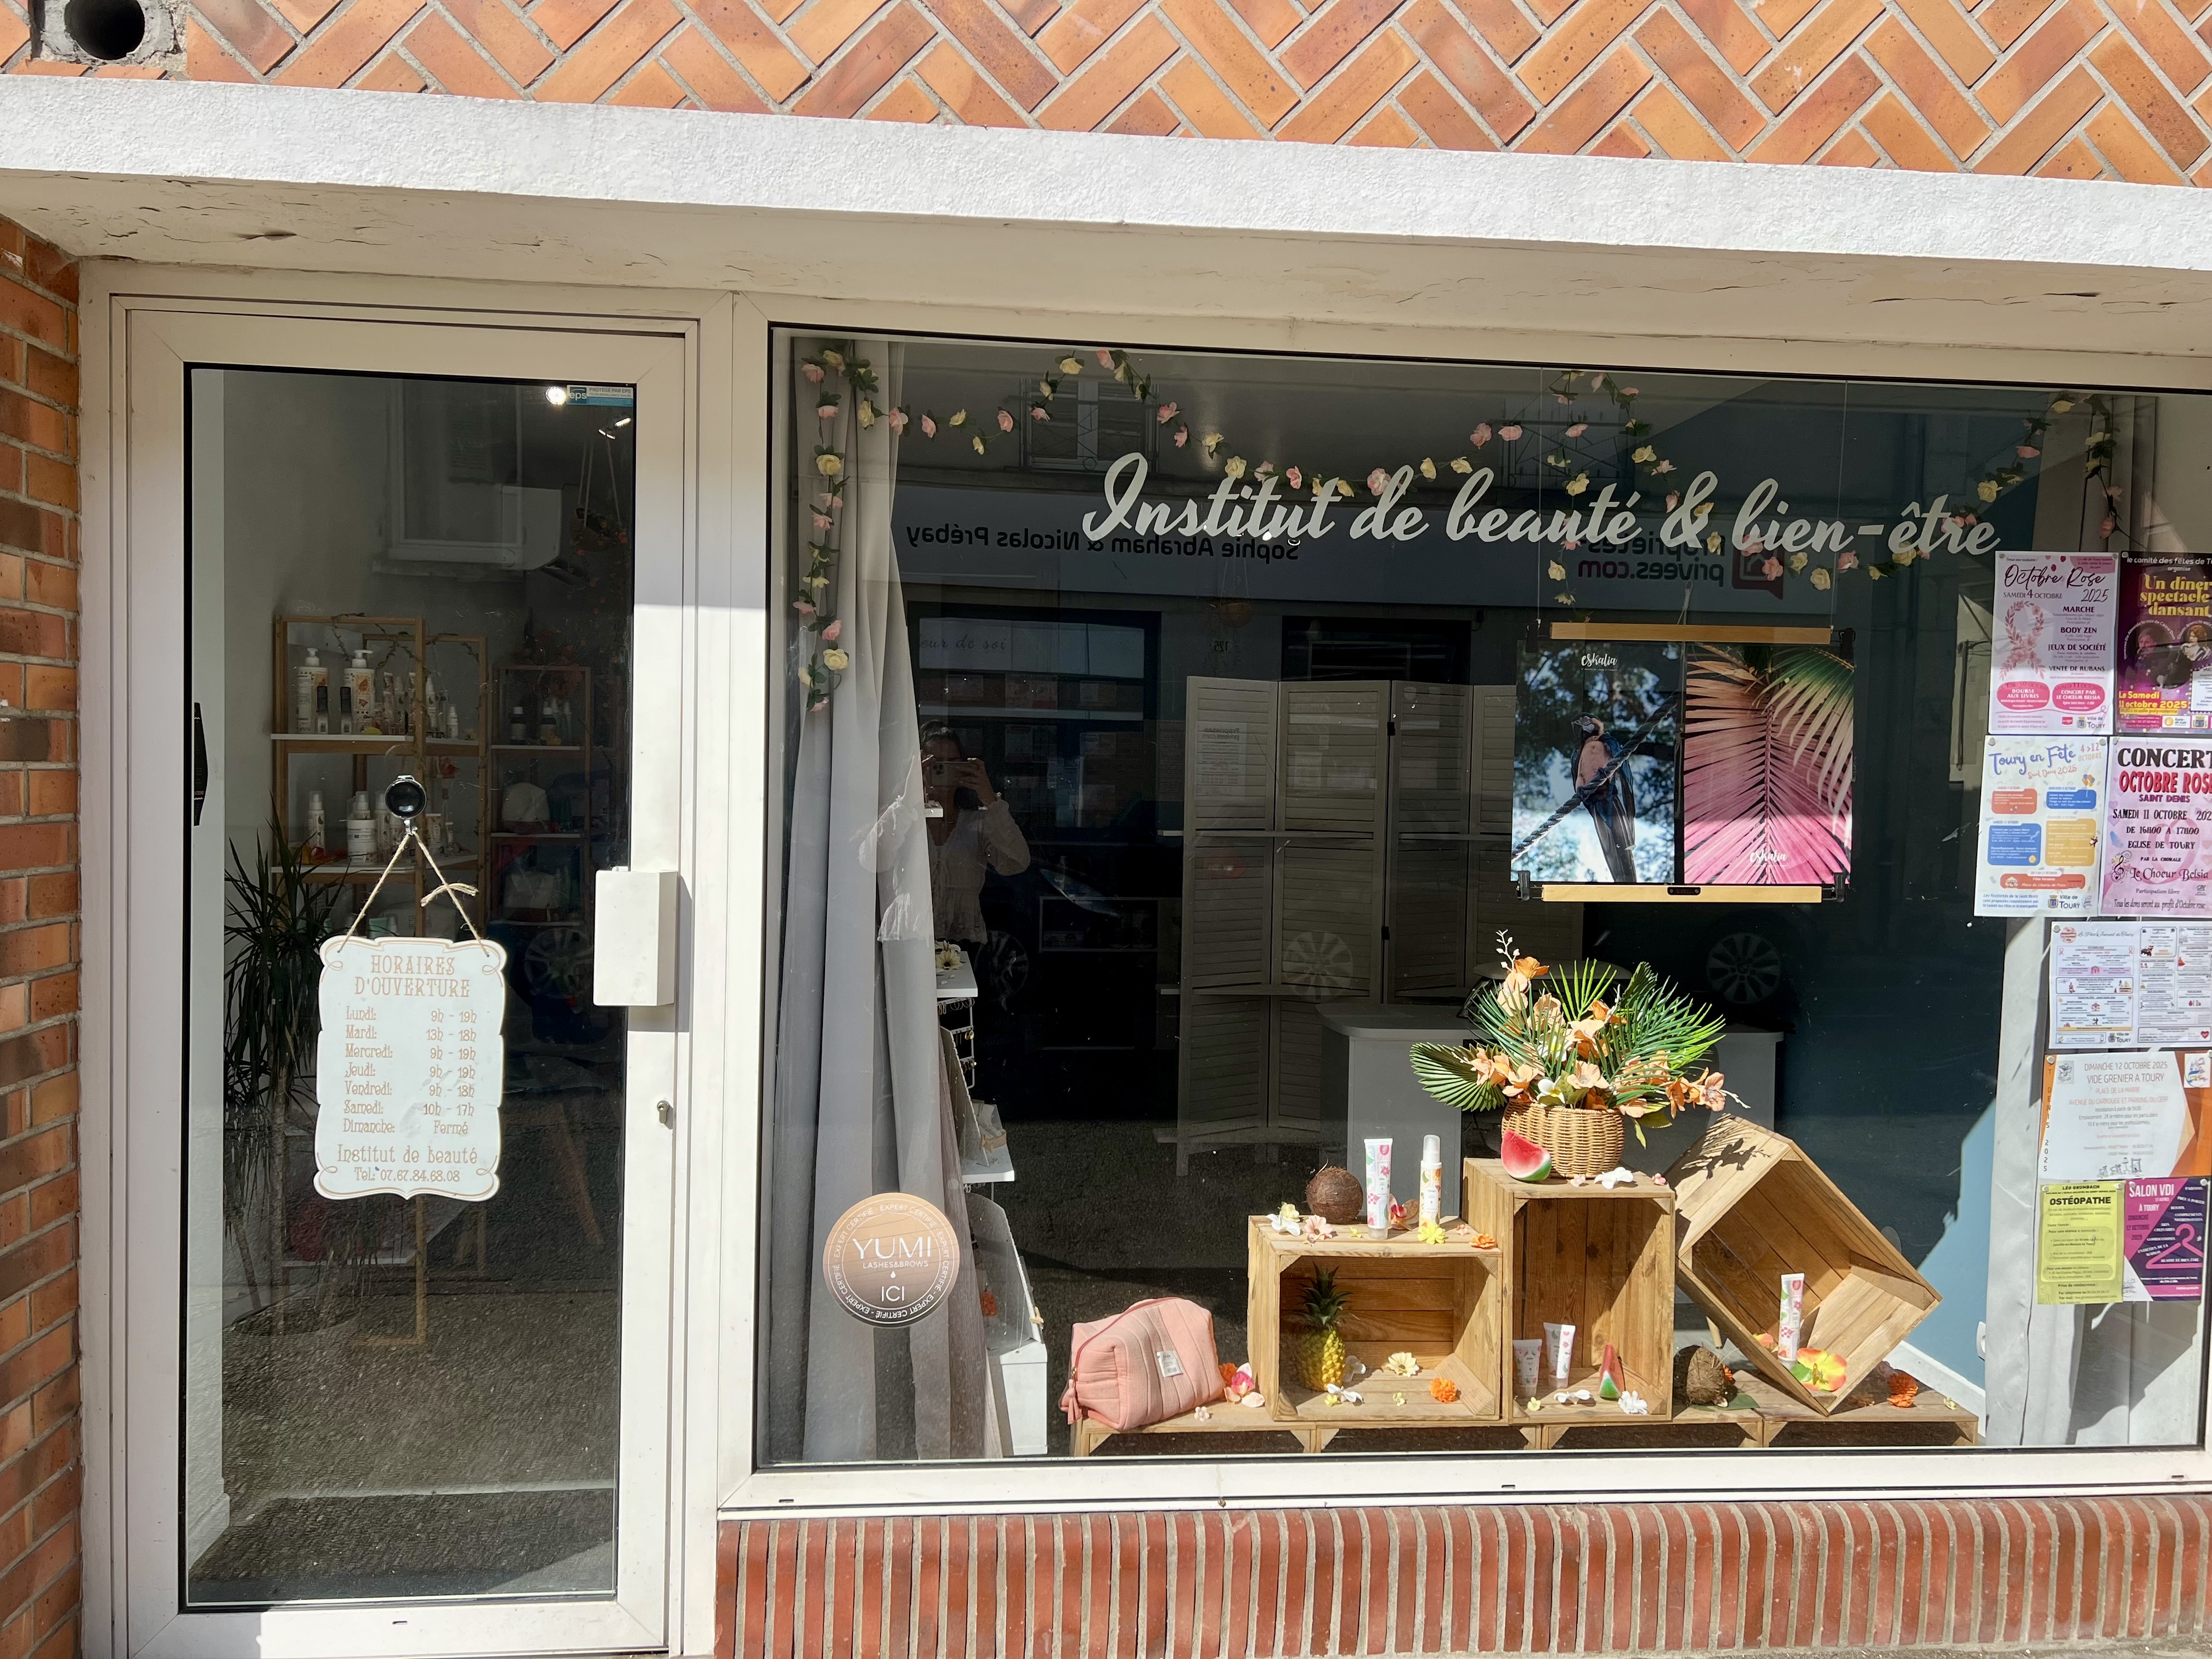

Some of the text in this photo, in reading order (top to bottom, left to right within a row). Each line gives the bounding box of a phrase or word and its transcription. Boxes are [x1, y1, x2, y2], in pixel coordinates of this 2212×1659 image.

[569, 392, 587, 401] eps
[1082, 452, 2001, 555] Institut de beauté & bien-être
[2174, 557, 2194, 565] fêtes
[2004, 564, 2106, 590] Octobre Rose
[2144, 573, 2166, 590] Un
[2027, 589, 2034, 599] 4
[2081, 589, 2109, 602] 2025
[2140, 588, 2210, 605] spectacle
[2148, 602, 2210, 616] dansant
[2079, 642, 2107, 651] SOCIÉTÉ
[2128, 691, 2160, 699] Samedi
[2159, 701, 2188, 709] 2025
[1988, 753, 2027, 775] Toury
[2030, 754, 2045, 762] en
[2078, 752, 2102, 762] OCTOBRE
[2057, 765, 2077, 775] 2025
[2119, 771, 2212, 794] OCTOBRE ROS
[2113, 809, 2212, 820] SAMEDI 11 OCTOBRE 202
[2128, 840, 2151, 849] EGLISE
[2129, 867, 2208, 882] Le Choeur Belsia
[2114, 899, 2123, 907] Tous
[2130, 898, 2140, 908] dons
[2162, 899, 2174, 911] profit
[2175, 899, 2196, 909] d'Octobre
[371, 955, 455, 975] HORAIRES
[354, 977, 470, 997] D'OUVERTURE
[346, 1006, 477, 1023] Lundi: 9h 19h
[345, 1025, 476, 1042] Mardi: 13h 18h
[345, 1043, 476, 1060] Mercredi: 9h 19h
[345, 1062, 475, 1079] Jeudi: 9h 19h
[2085, 1062, 2113, 1071] DIMANCHE
[2124, 1062, 2151, 1070] OCTOBRE
[2152, 1061, 2168, 1069] 2025
[2087, 1073, 2165, 1084] VIDE GRENIER A TOURY
[345, 1081, 475, 1098] Vendredi: 9h 18h
[343, 1100, 474, 1116] Samedi: 10h 17h
[343, 1119, 468, 1135] Dimanche: Fermé
[337, 1144, 477, 1164] Institut de beauté
[380, 1170, 460, 1182] 07.67.84.68.08
[2129, 1184, 2174, 1197] SALON VDI
[880, 1204, 909, 1212] EXPERT
[2050, 1195, 2112, 1206] OSTÉOPATHE
[2138, 1203, 2142, 1212] À
[833, 1207, 874, 1258] EXPERT CERTIFIÉ
[853, 1237, 931, 1260] YUMI
[863, 1260, 928, 1269] LASHES&BROWS
[934, 1231, 950, 1292] EXPERT CERTIFIÉ
[833, 1264, 871, 1315] EXPERT CERTIFIÉ
[881, 1285, 905, 1302] ICI
[876, 1294, 934, 1319] EXPERT CERTIFIÉ
